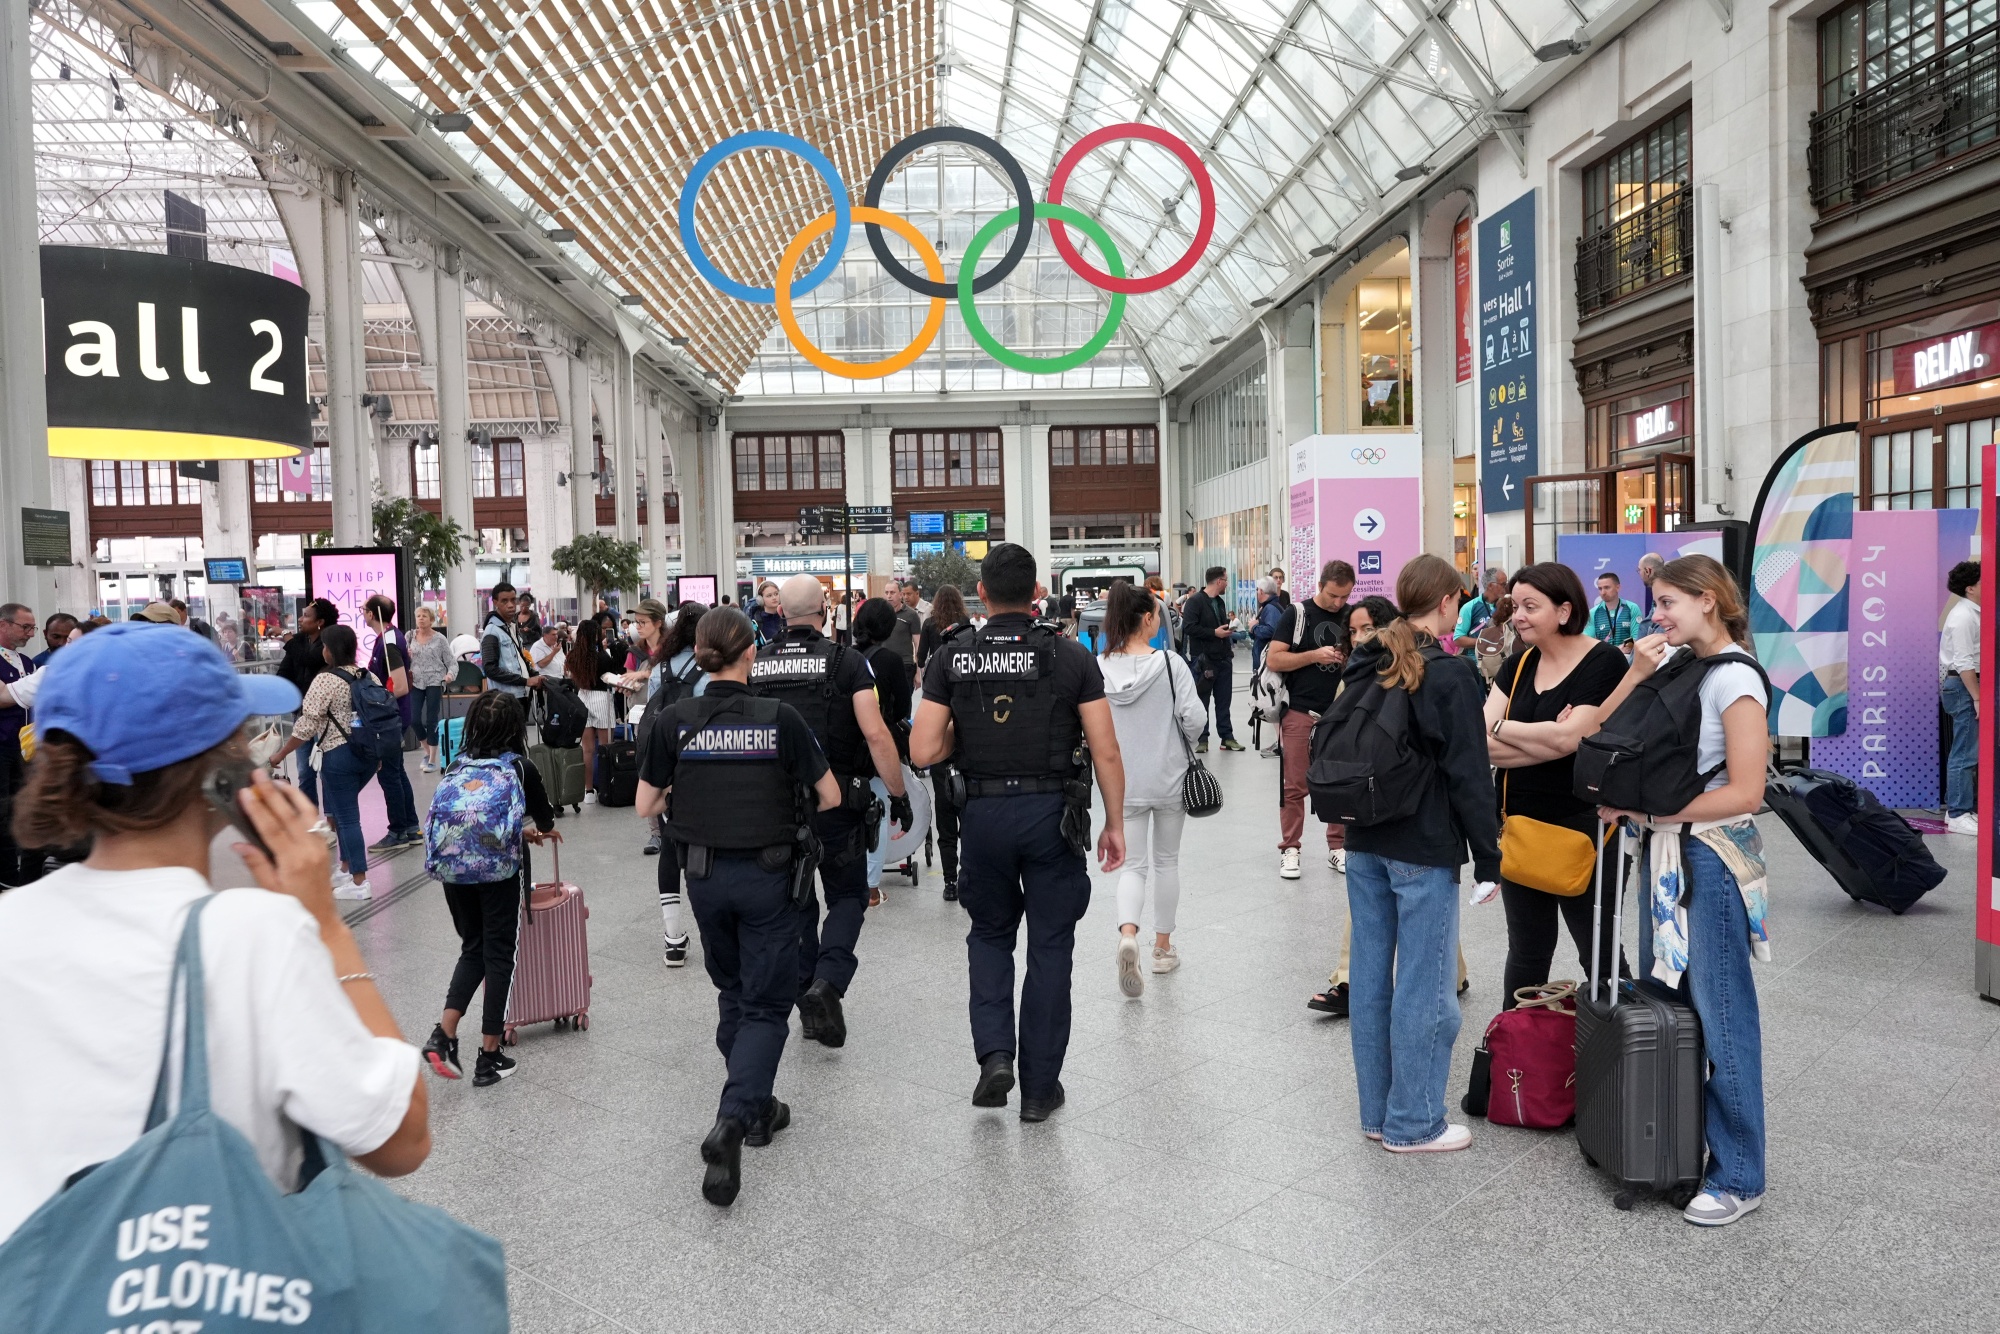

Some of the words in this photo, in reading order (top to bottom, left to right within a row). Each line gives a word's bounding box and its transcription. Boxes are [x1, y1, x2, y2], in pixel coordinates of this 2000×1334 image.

[1497, 253, 1514, 272] Sortie
[1483, 298, 1497, 313] vers
[1499, 285, 1523, 318] Hall
[1525, 280, 1532, 305] 1
[41, 297, 212, 385] all
[249, 319, 285, 396] 2
[1501, 337, 1510, 360] A
[1512, 330, 1517, 343] à
[1520, 328, 1529, 353] N
[326, 572, 352, 583] VIN
[359, 571, 384, 582] IGP
[764, 558, 804, 572] MAISON
[1861, 545, 1887, 648] 2024
[751, 658, 827, 678] GENDARMERIE
[952, 651, 1036, 674] GENDARMERIE
[1862, 664, 1888, 779] PARIS
[115, 1204, 212, 1262] USE
[106, 1259, 313, 1326] CLOTHES
